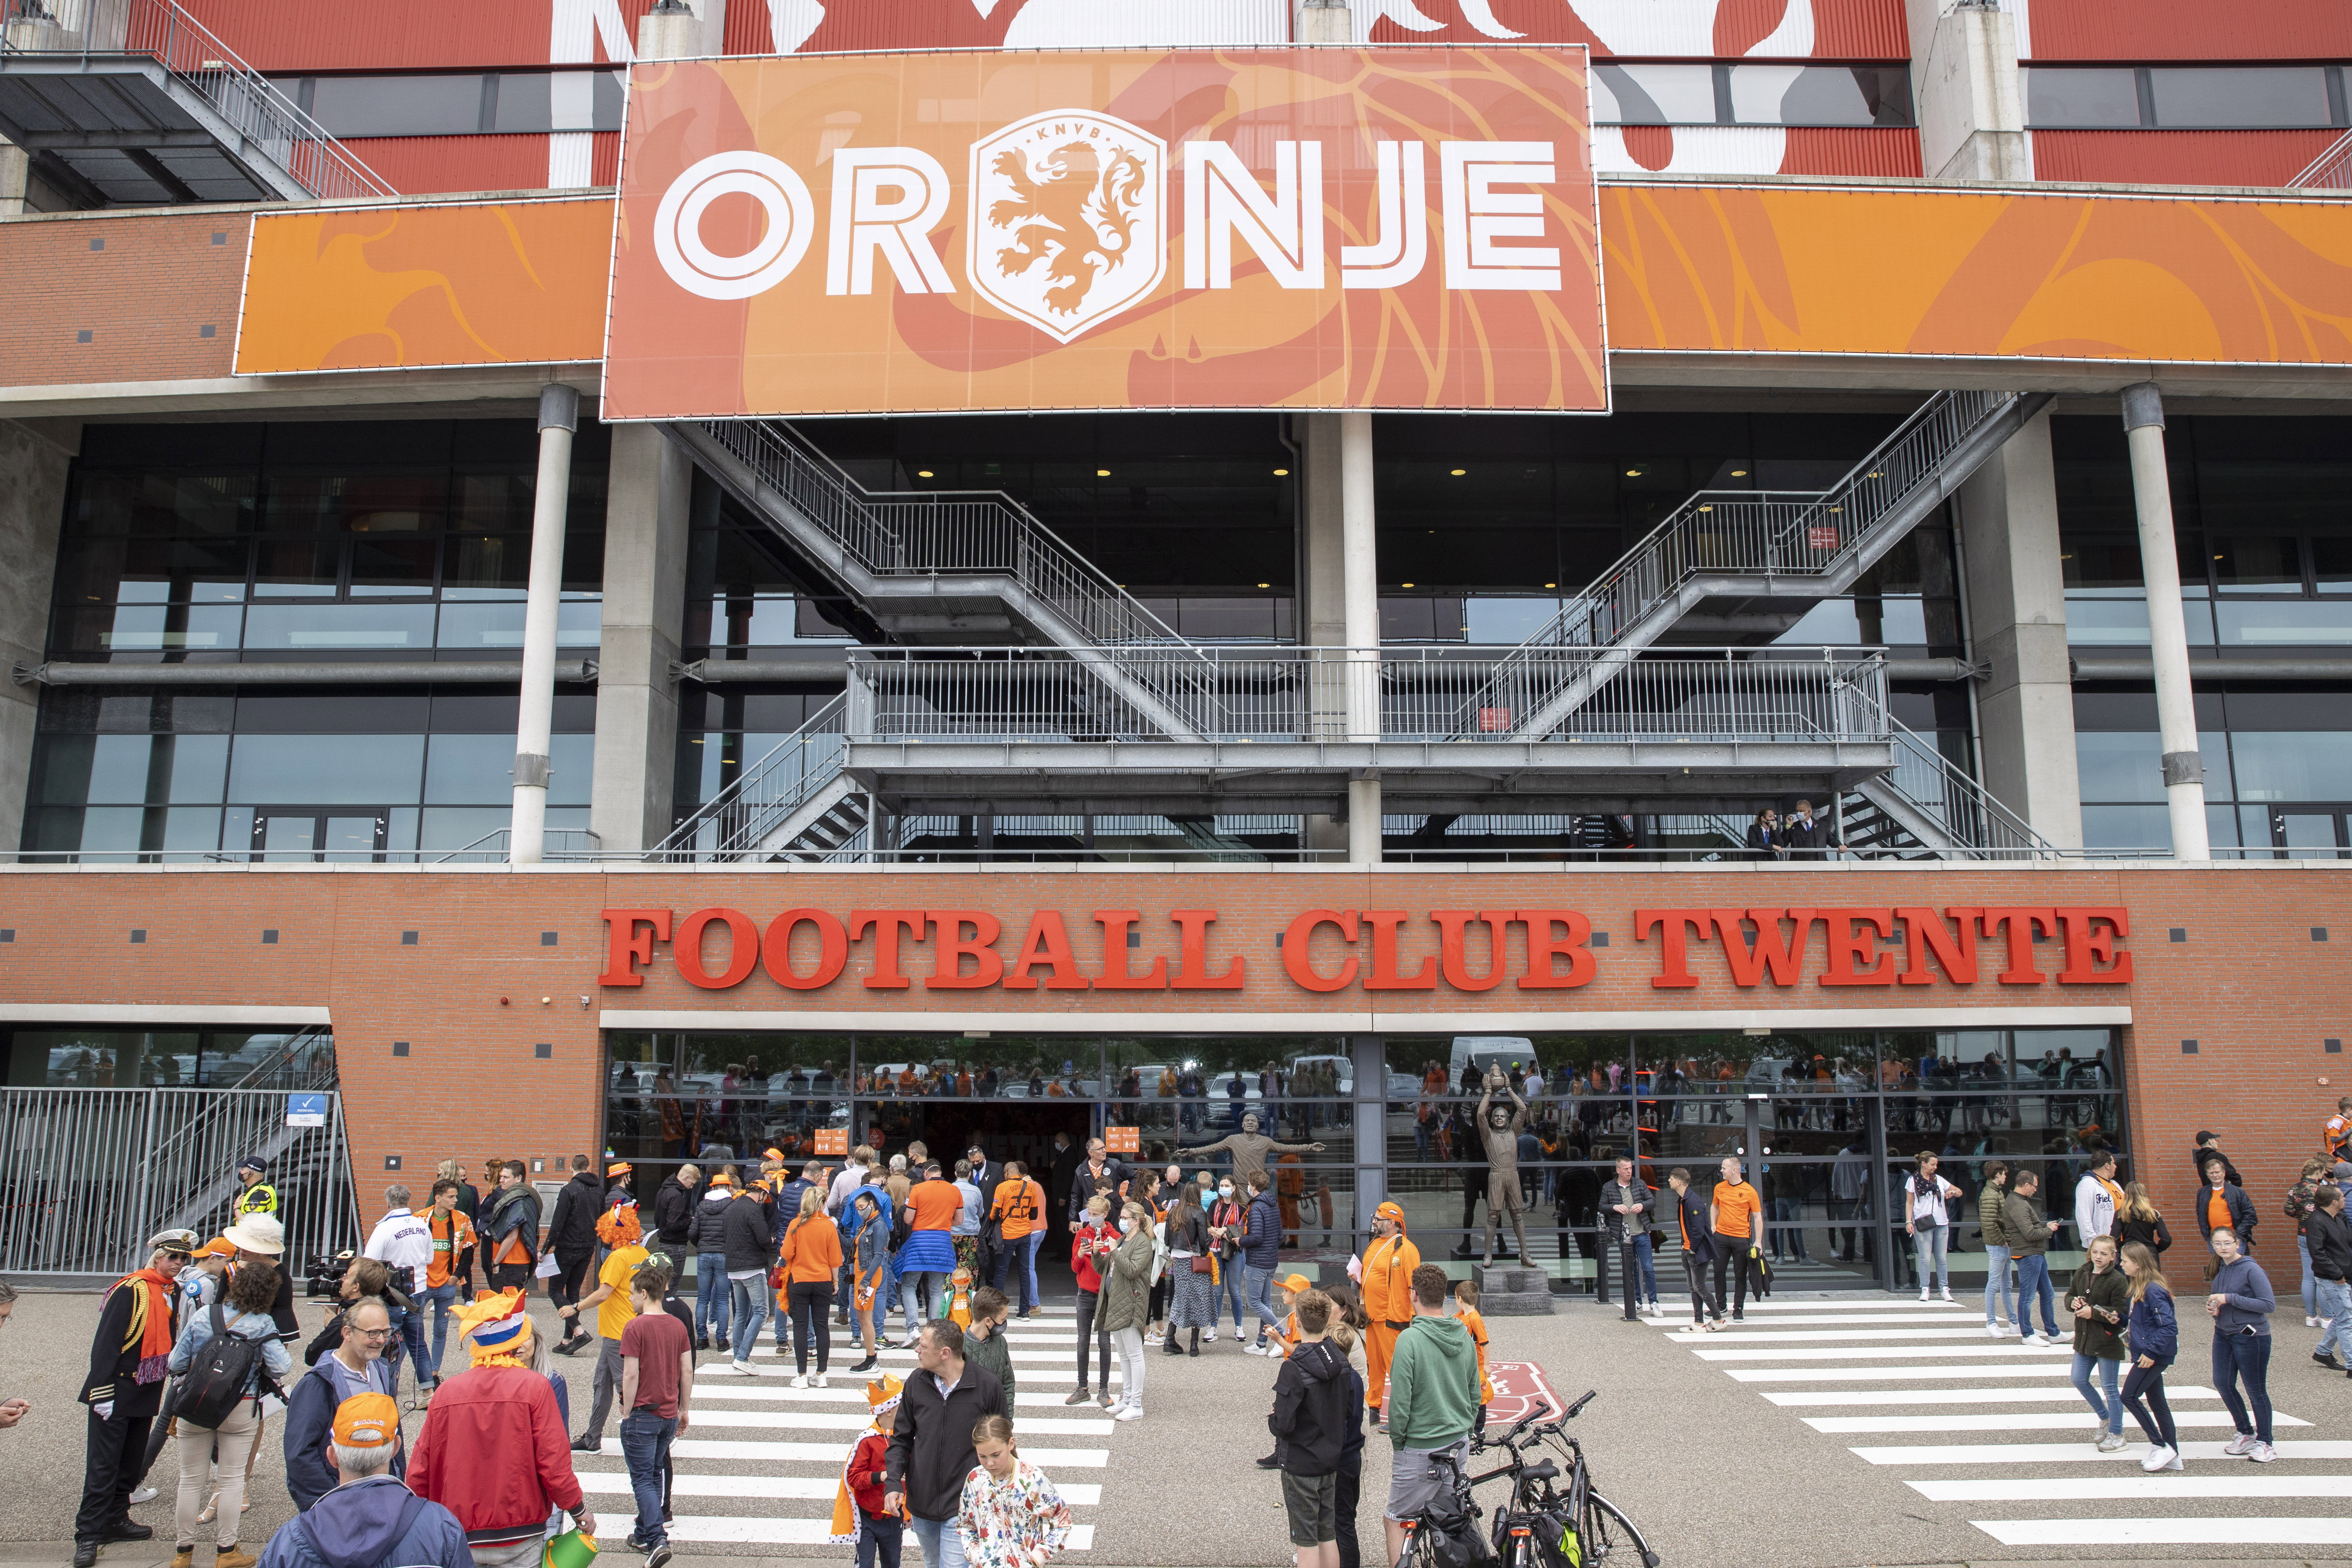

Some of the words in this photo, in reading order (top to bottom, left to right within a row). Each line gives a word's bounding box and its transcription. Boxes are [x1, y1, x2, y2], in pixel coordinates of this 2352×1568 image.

[1036, 124, 1100, 140] KNVB
[598, 906, 1244, 992] FOOTBALL
[1282, 908, 1597, 994] CLUB
[1633, 906, 2134, 988] TWENTE
[394, 1227, 426, 1241] NEDERLAND
